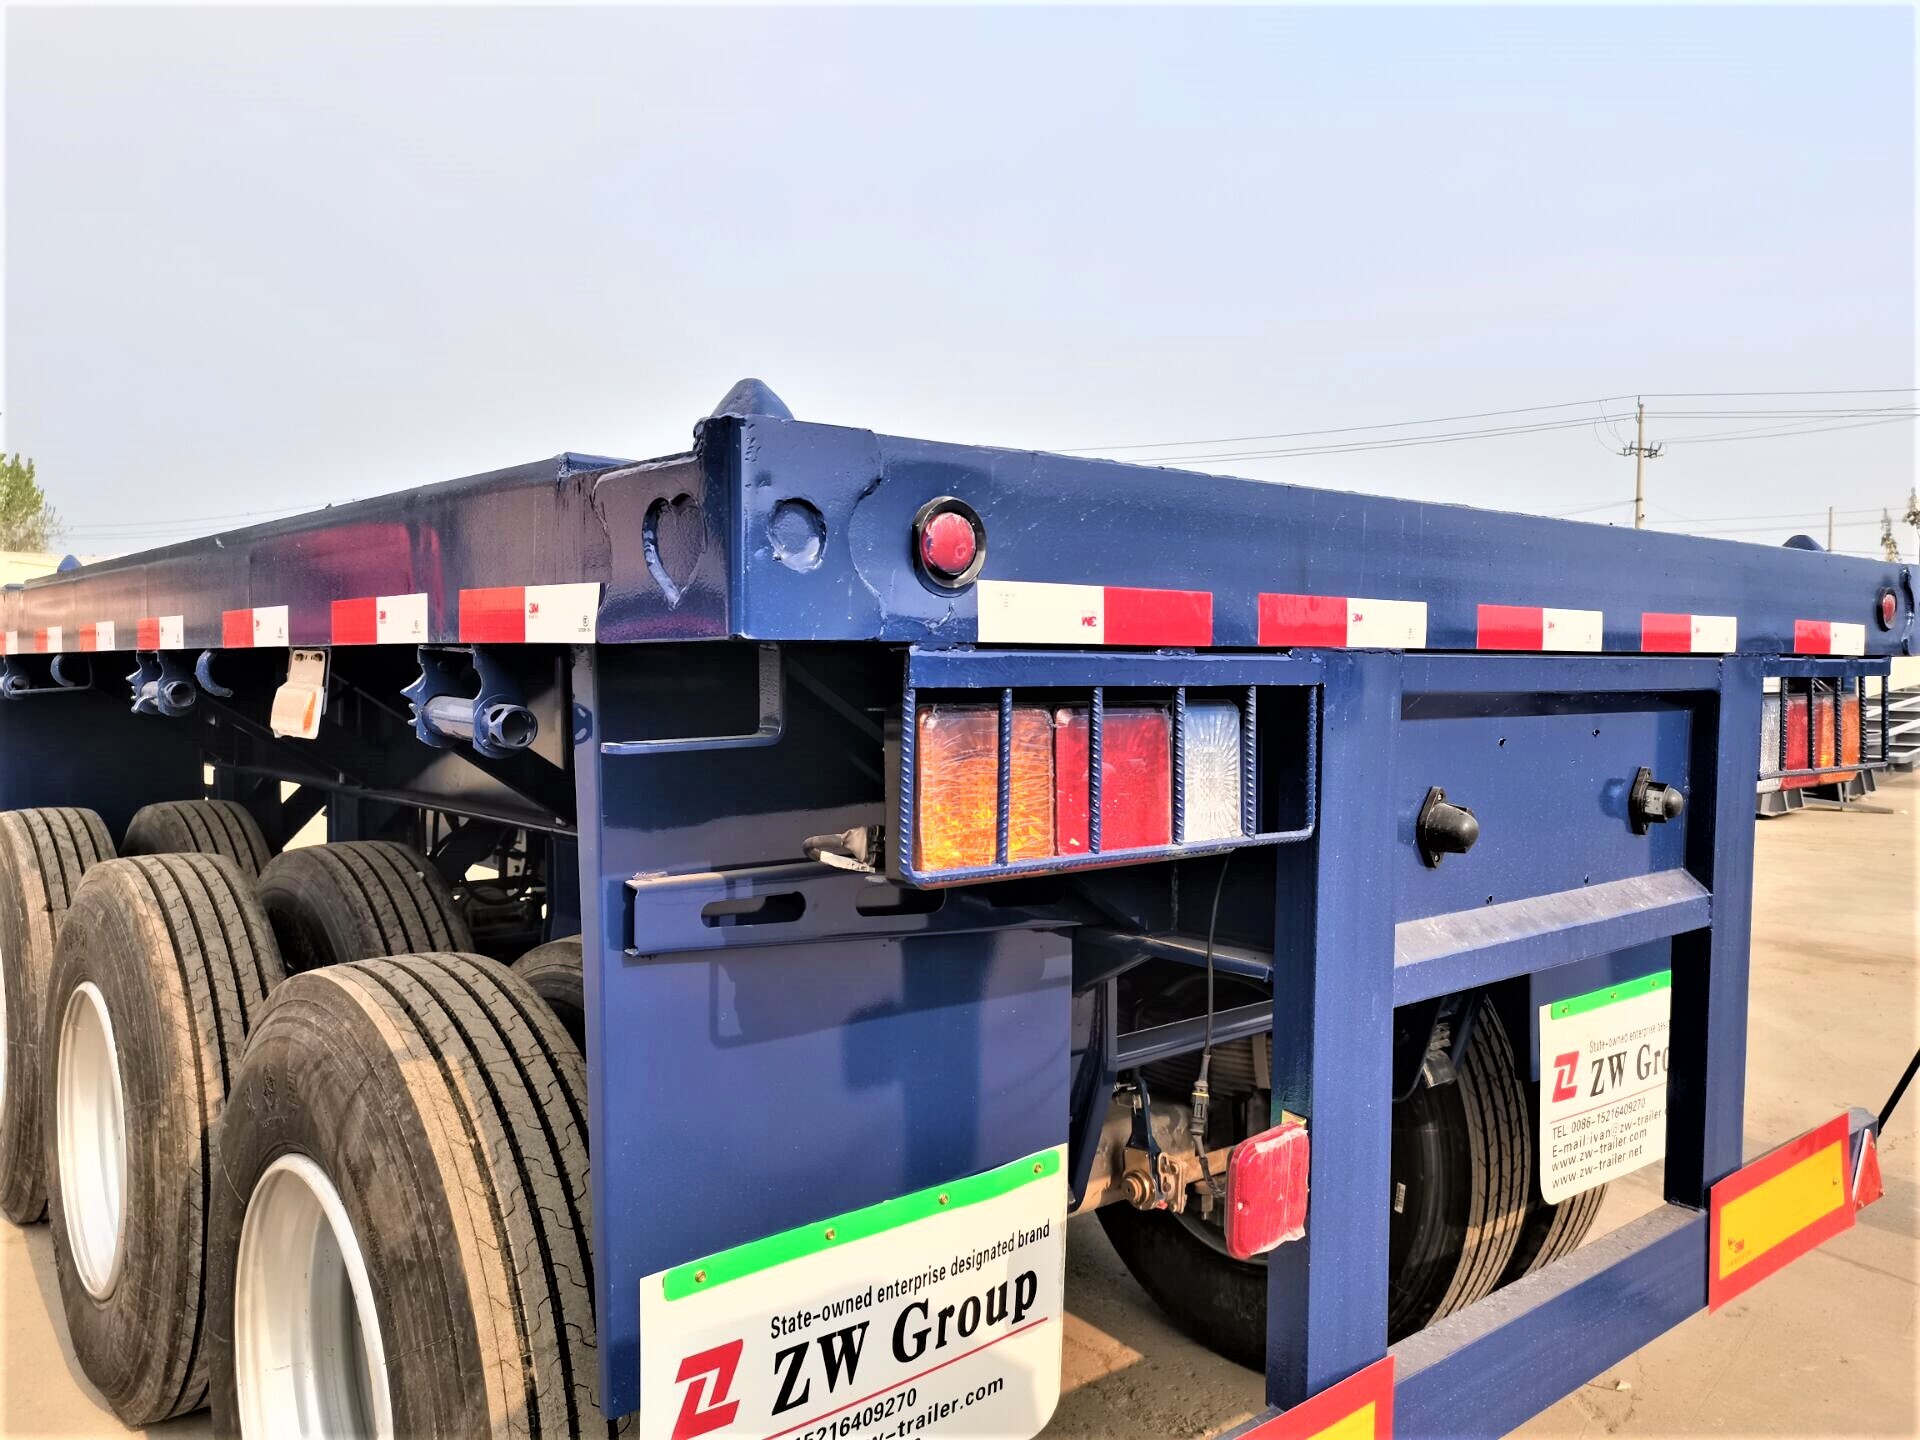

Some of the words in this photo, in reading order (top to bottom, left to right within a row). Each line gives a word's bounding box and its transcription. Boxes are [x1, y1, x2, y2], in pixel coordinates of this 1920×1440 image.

[1081, 616, 1097, 627] 3M
[1629, 1023, 1656, 1040] enterprise
[1590, 1050, 1627, 1097] ZW
[1552, 1128, 1647, 1172] www.zw-trailer.com
[1552, 1144, 1643, 1189] www.zw-trailer.net
[771, 1285, 872, 1339] State-owned
[877, 1265, 946, 1303] enterprise
[951, 1232, 1015, 1276] designated
[1018, 1218, 1050, 1248] brand
[771, 1320, 870, 1416] ZW
[892, 1270, 1038, 1364] Group
